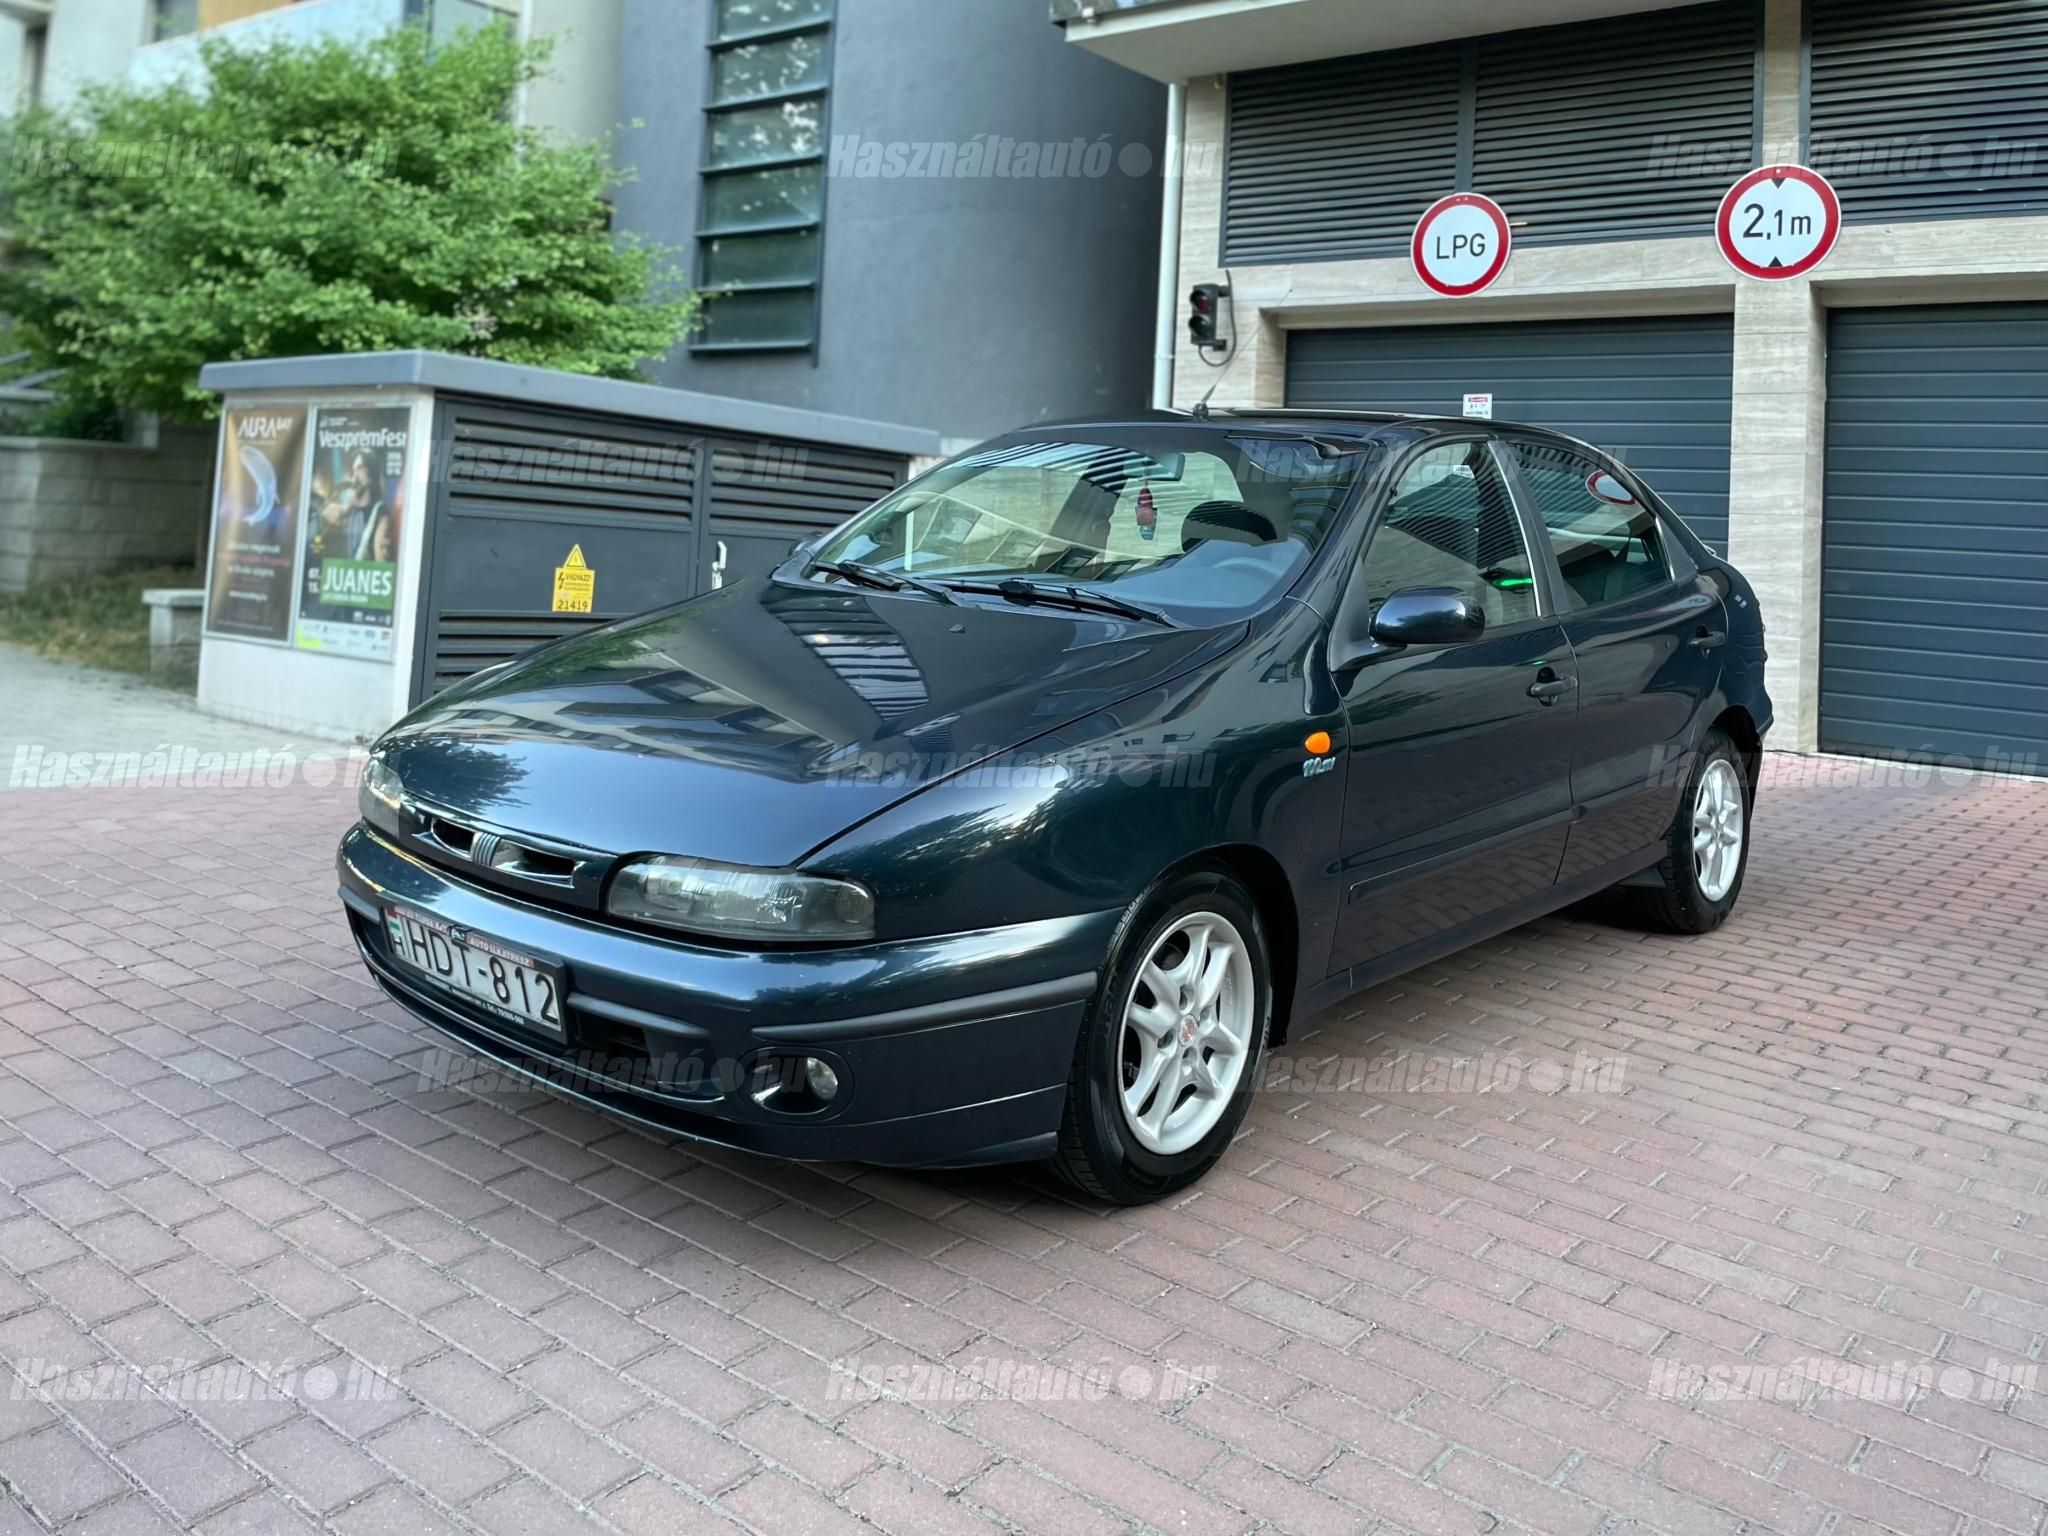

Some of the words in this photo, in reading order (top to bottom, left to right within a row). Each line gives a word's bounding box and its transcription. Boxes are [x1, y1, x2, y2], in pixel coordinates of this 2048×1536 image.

[1435, 232, 1486, 261] LPG
[321, 566, 393, 597] JUANES
[557, 599, 589, 610] 21419
[405, 915, 560, 1026] HDT-812
